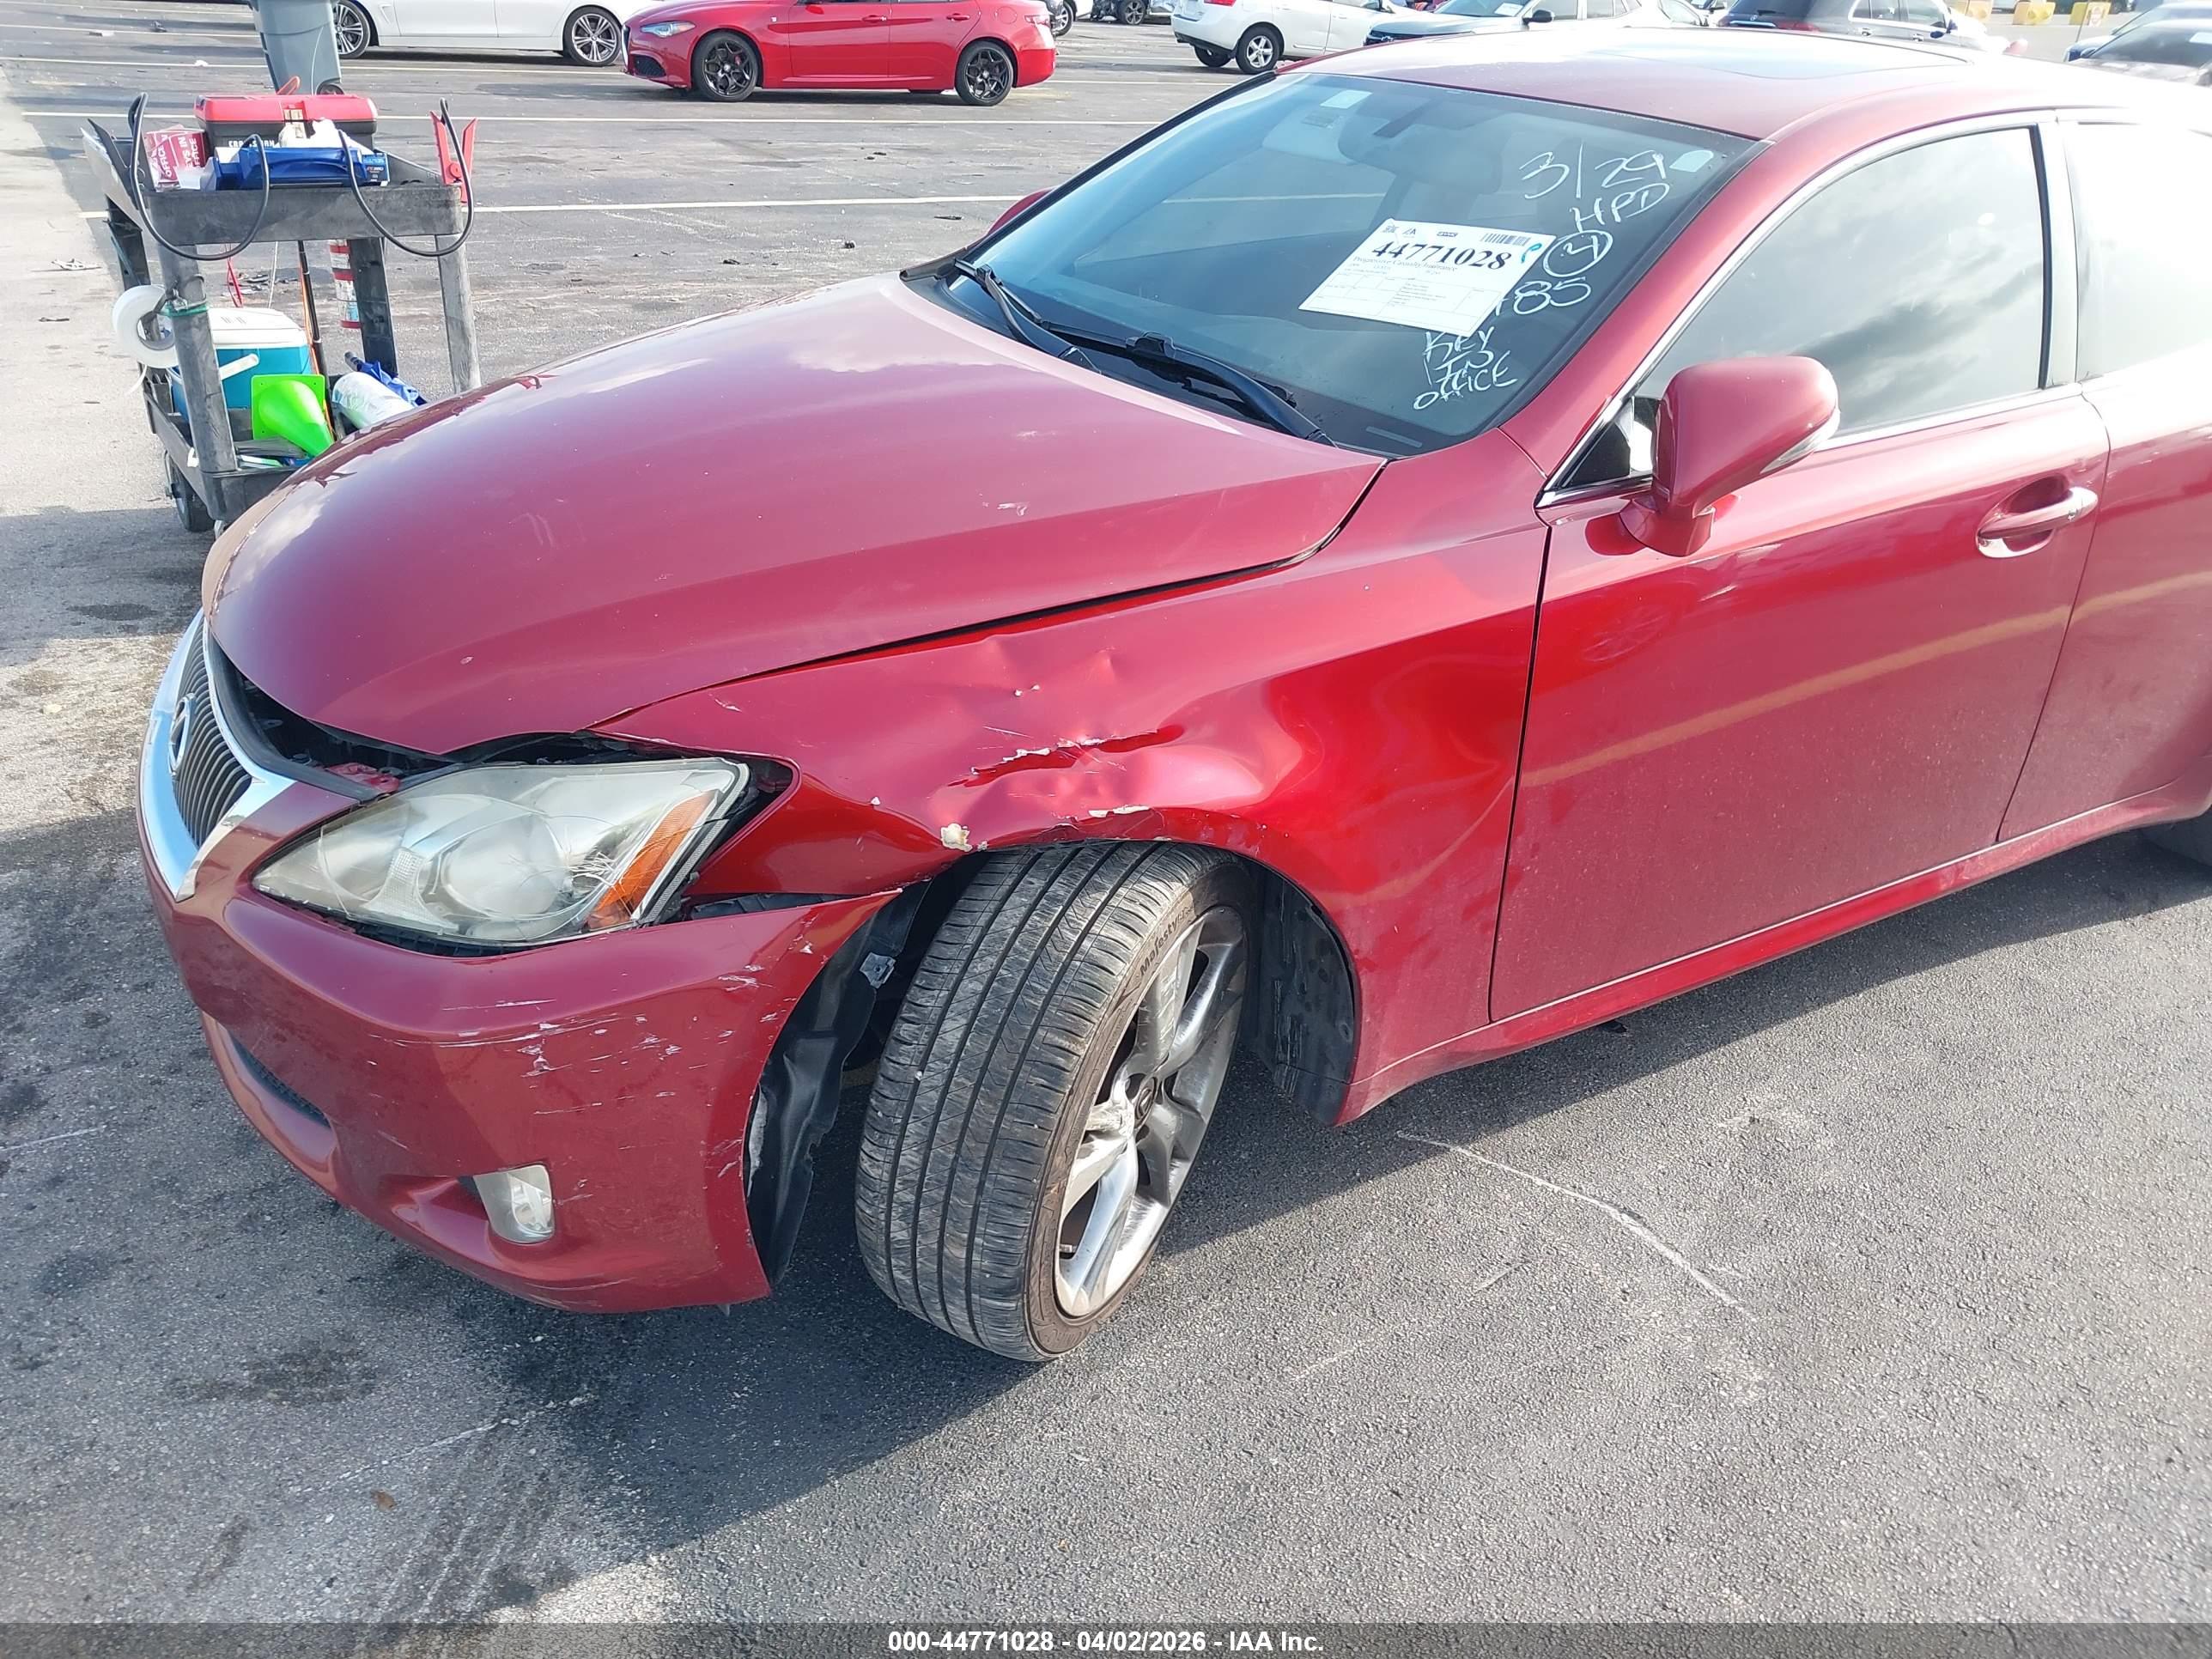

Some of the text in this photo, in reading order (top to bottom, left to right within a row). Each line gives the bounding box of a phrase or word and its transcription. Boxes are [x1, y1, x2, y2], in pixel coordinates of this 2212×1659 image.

[183, 150, 193, 168] EYS
[189, 137, 201, 166] FFICE
[1519, 143, 1667, 199] 3/29
[1569, 182, 1670, 233] HPD
[1371, 240, 1512, 270] 44771028
[1423, 326, 1495, 362] KEY
[1413, 349, 1518, 410] OFFICE
